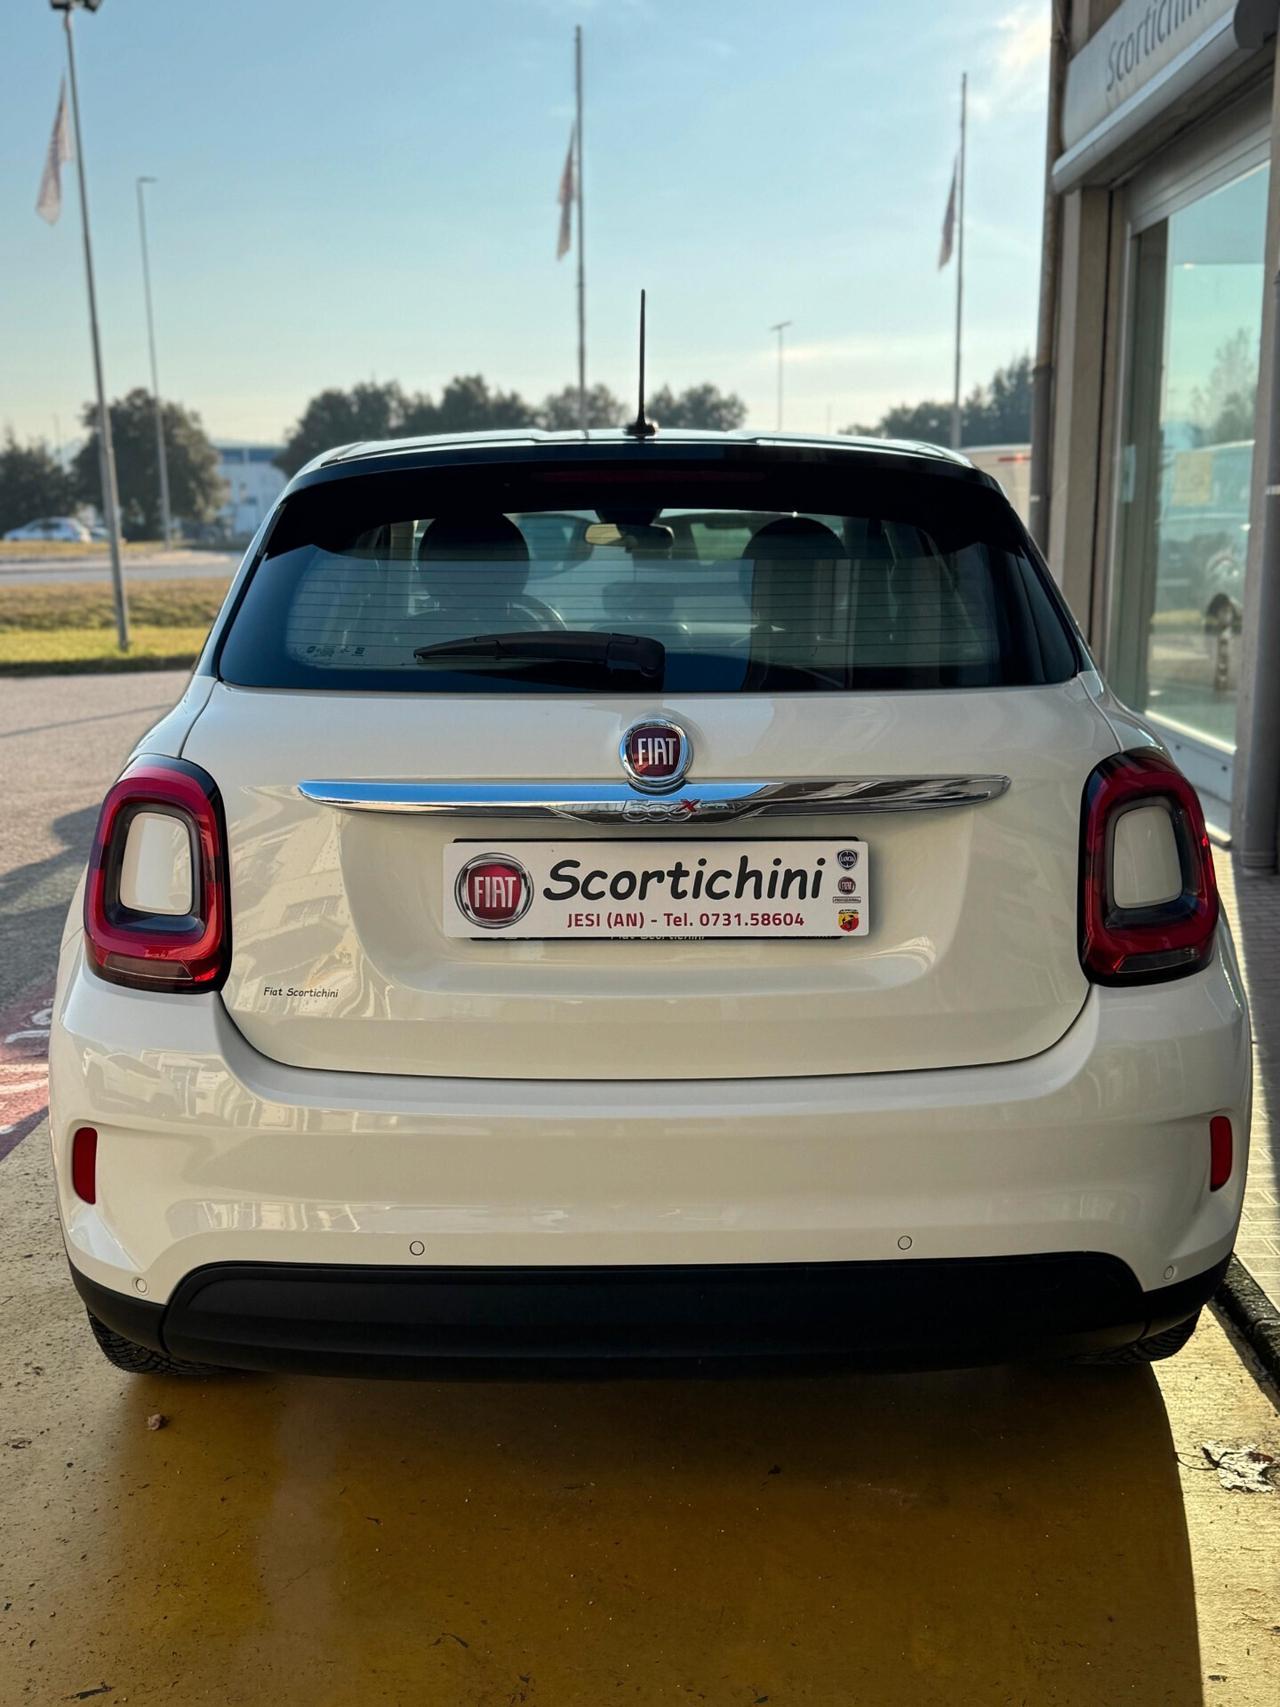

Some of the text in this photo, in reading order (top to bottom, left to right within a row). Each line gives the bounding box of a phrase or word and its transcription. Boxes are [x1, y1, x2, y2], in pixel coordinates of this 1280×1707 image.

[637, 737, 677, 766] FIAT
[473, 875, 517, 909] FIAT
[542, 855, 826, 901] Scortichini
[567, 912, 600, 928] JESI
[606, 912, 645, 929] (AN)
[663, 912, 694, 927] Tel.
[699, 912, 805, 928] 0731.58604
[263, 986, 339, 998] Fiat Scortichini
